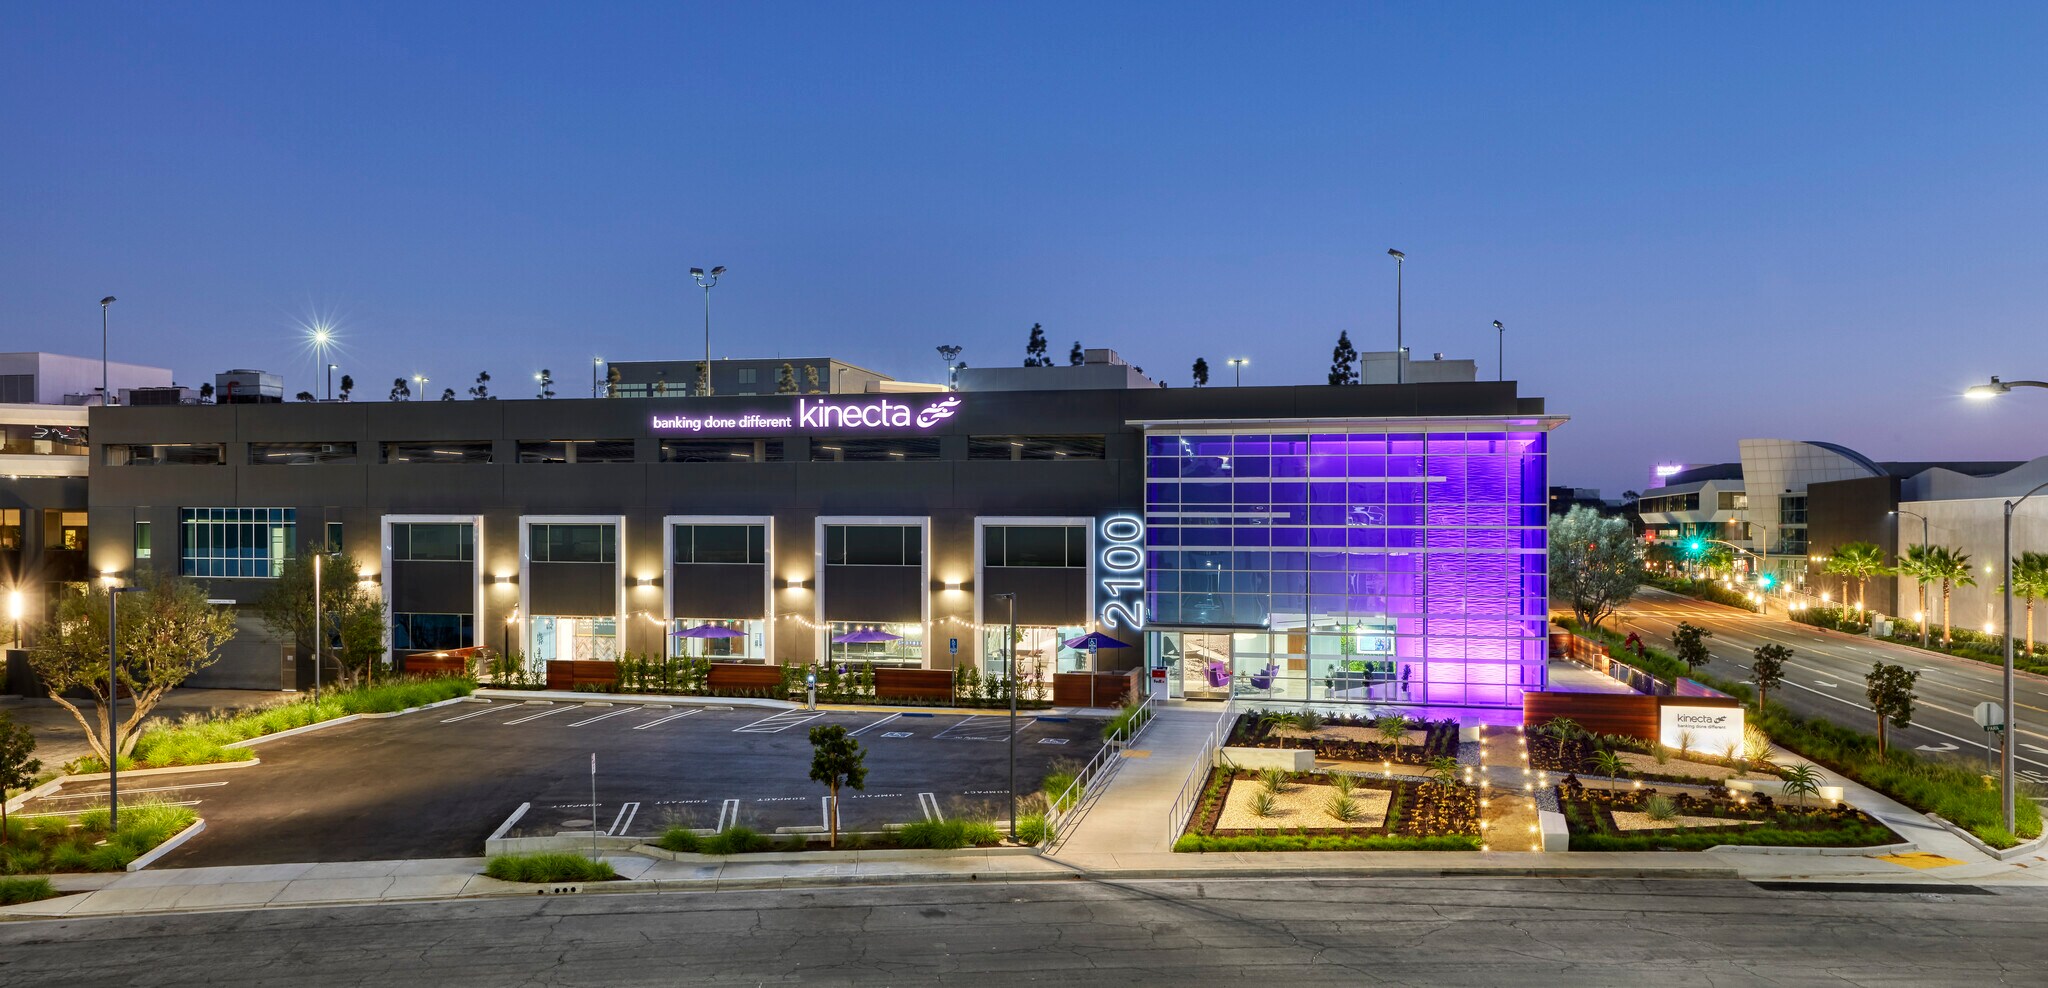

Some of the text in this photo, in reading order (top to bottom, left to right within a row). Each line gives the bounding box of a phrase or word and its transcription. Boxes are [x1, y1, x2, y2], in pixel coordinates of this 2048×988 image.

[653, 415, 792, 431] banking done different
[799, 399, 911, 428] kinecta
[1102, 515, 1143, 630] 2100
[1677, 714, 1712, 723] kinecta
